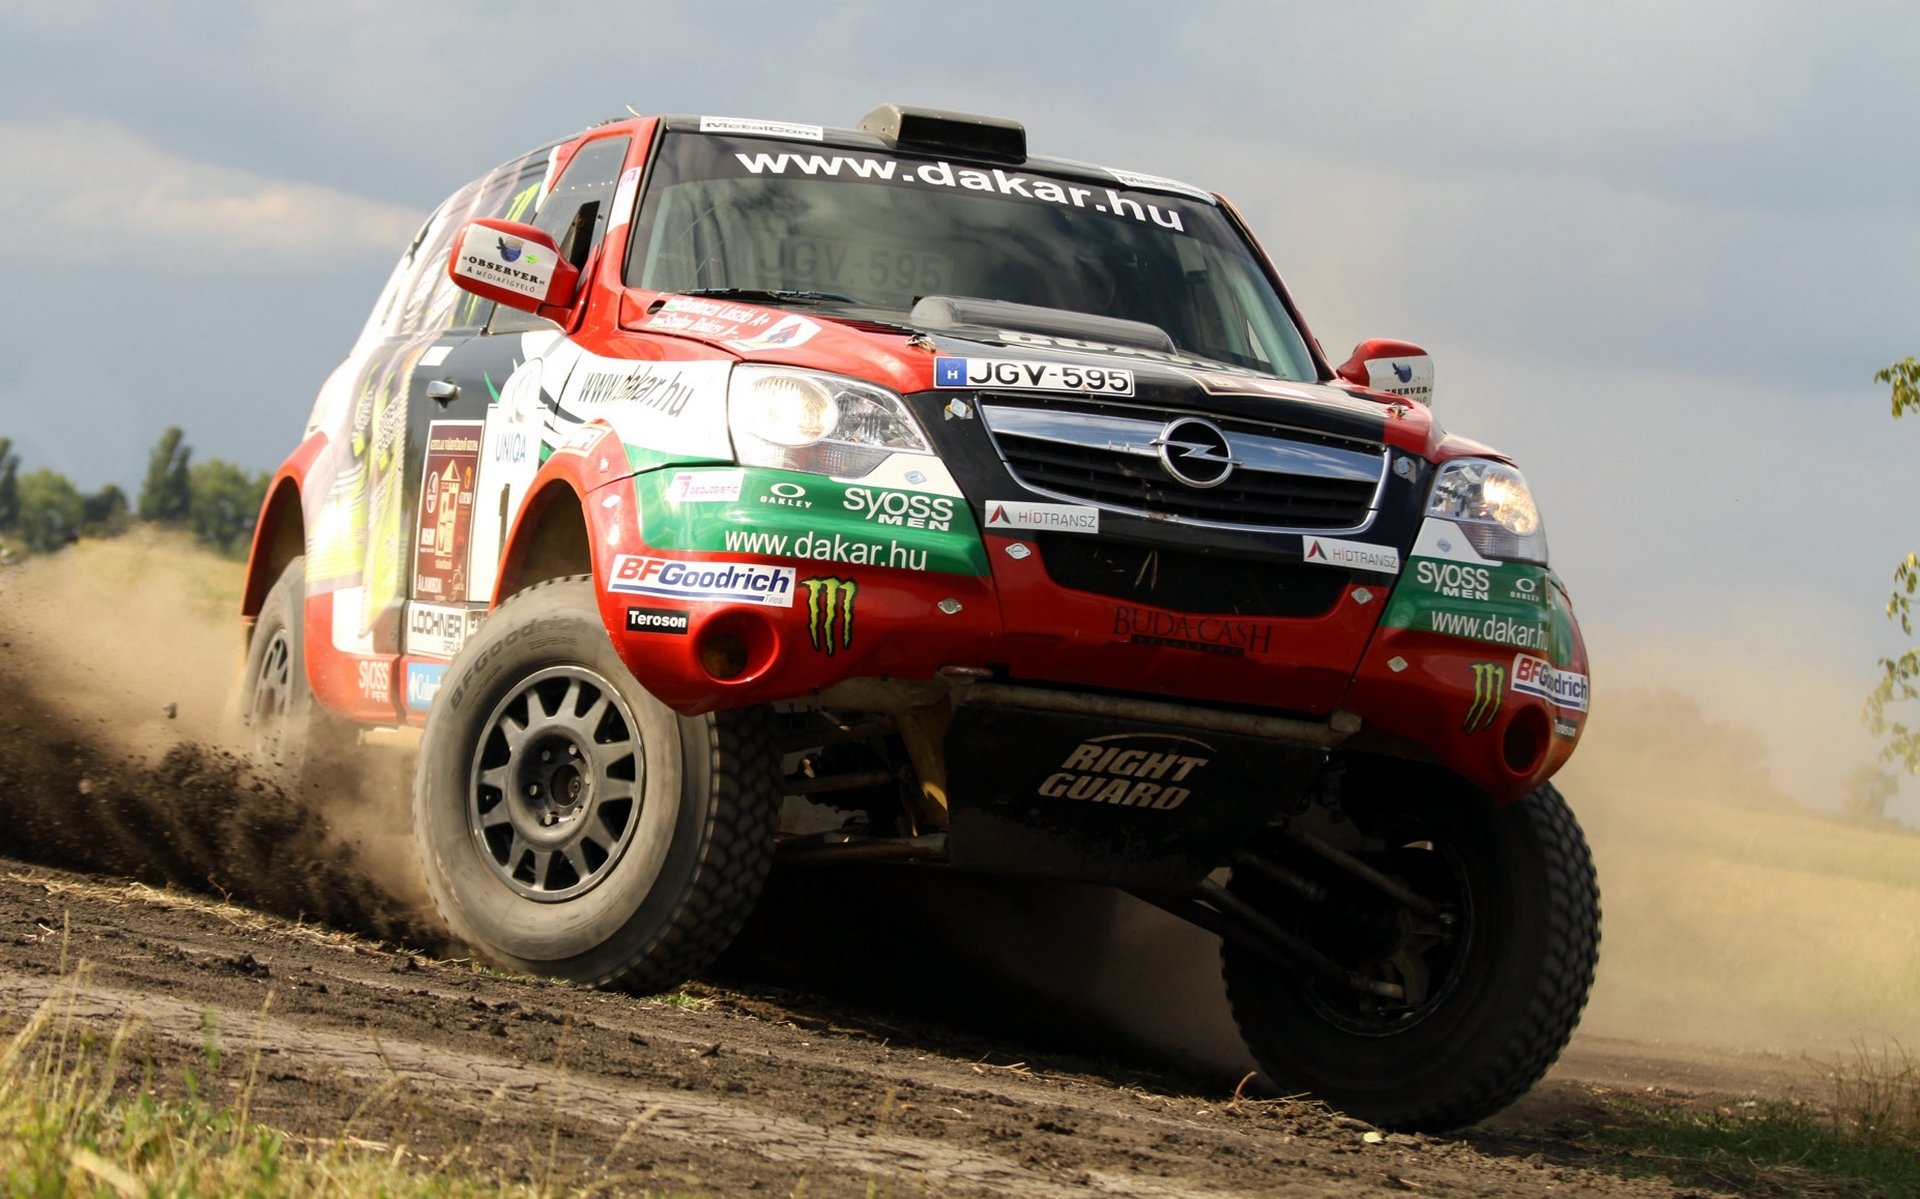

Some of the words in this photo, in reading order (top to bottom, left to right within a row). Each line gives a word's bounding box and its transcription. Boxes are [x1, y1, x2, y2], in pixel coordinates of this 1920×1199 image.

[735, 153, 1185, 232] www.dakar.hu
[578, 364, 694, 418] www.dakar.hu
[969, 362, 1130, 393] JGV-595
[760, 495, 813, 509] OAKLEY
[878, 513, 950, 532] MEN
[1018, 509, 1096, 528] HÍDTRANSZ
[724, 529, 928, 572] www.dakar.hu
[616, 557, 790, 594] BFGoodrich
[1442, 586, 1489, 601] MEN
[411, 609, 462, 640] LOCHNER
[629, 610, 687, 629] Teroson
[1061, 743, 1209, 782] RIGHT
[1038, 772, 1191, 810] GUARD
